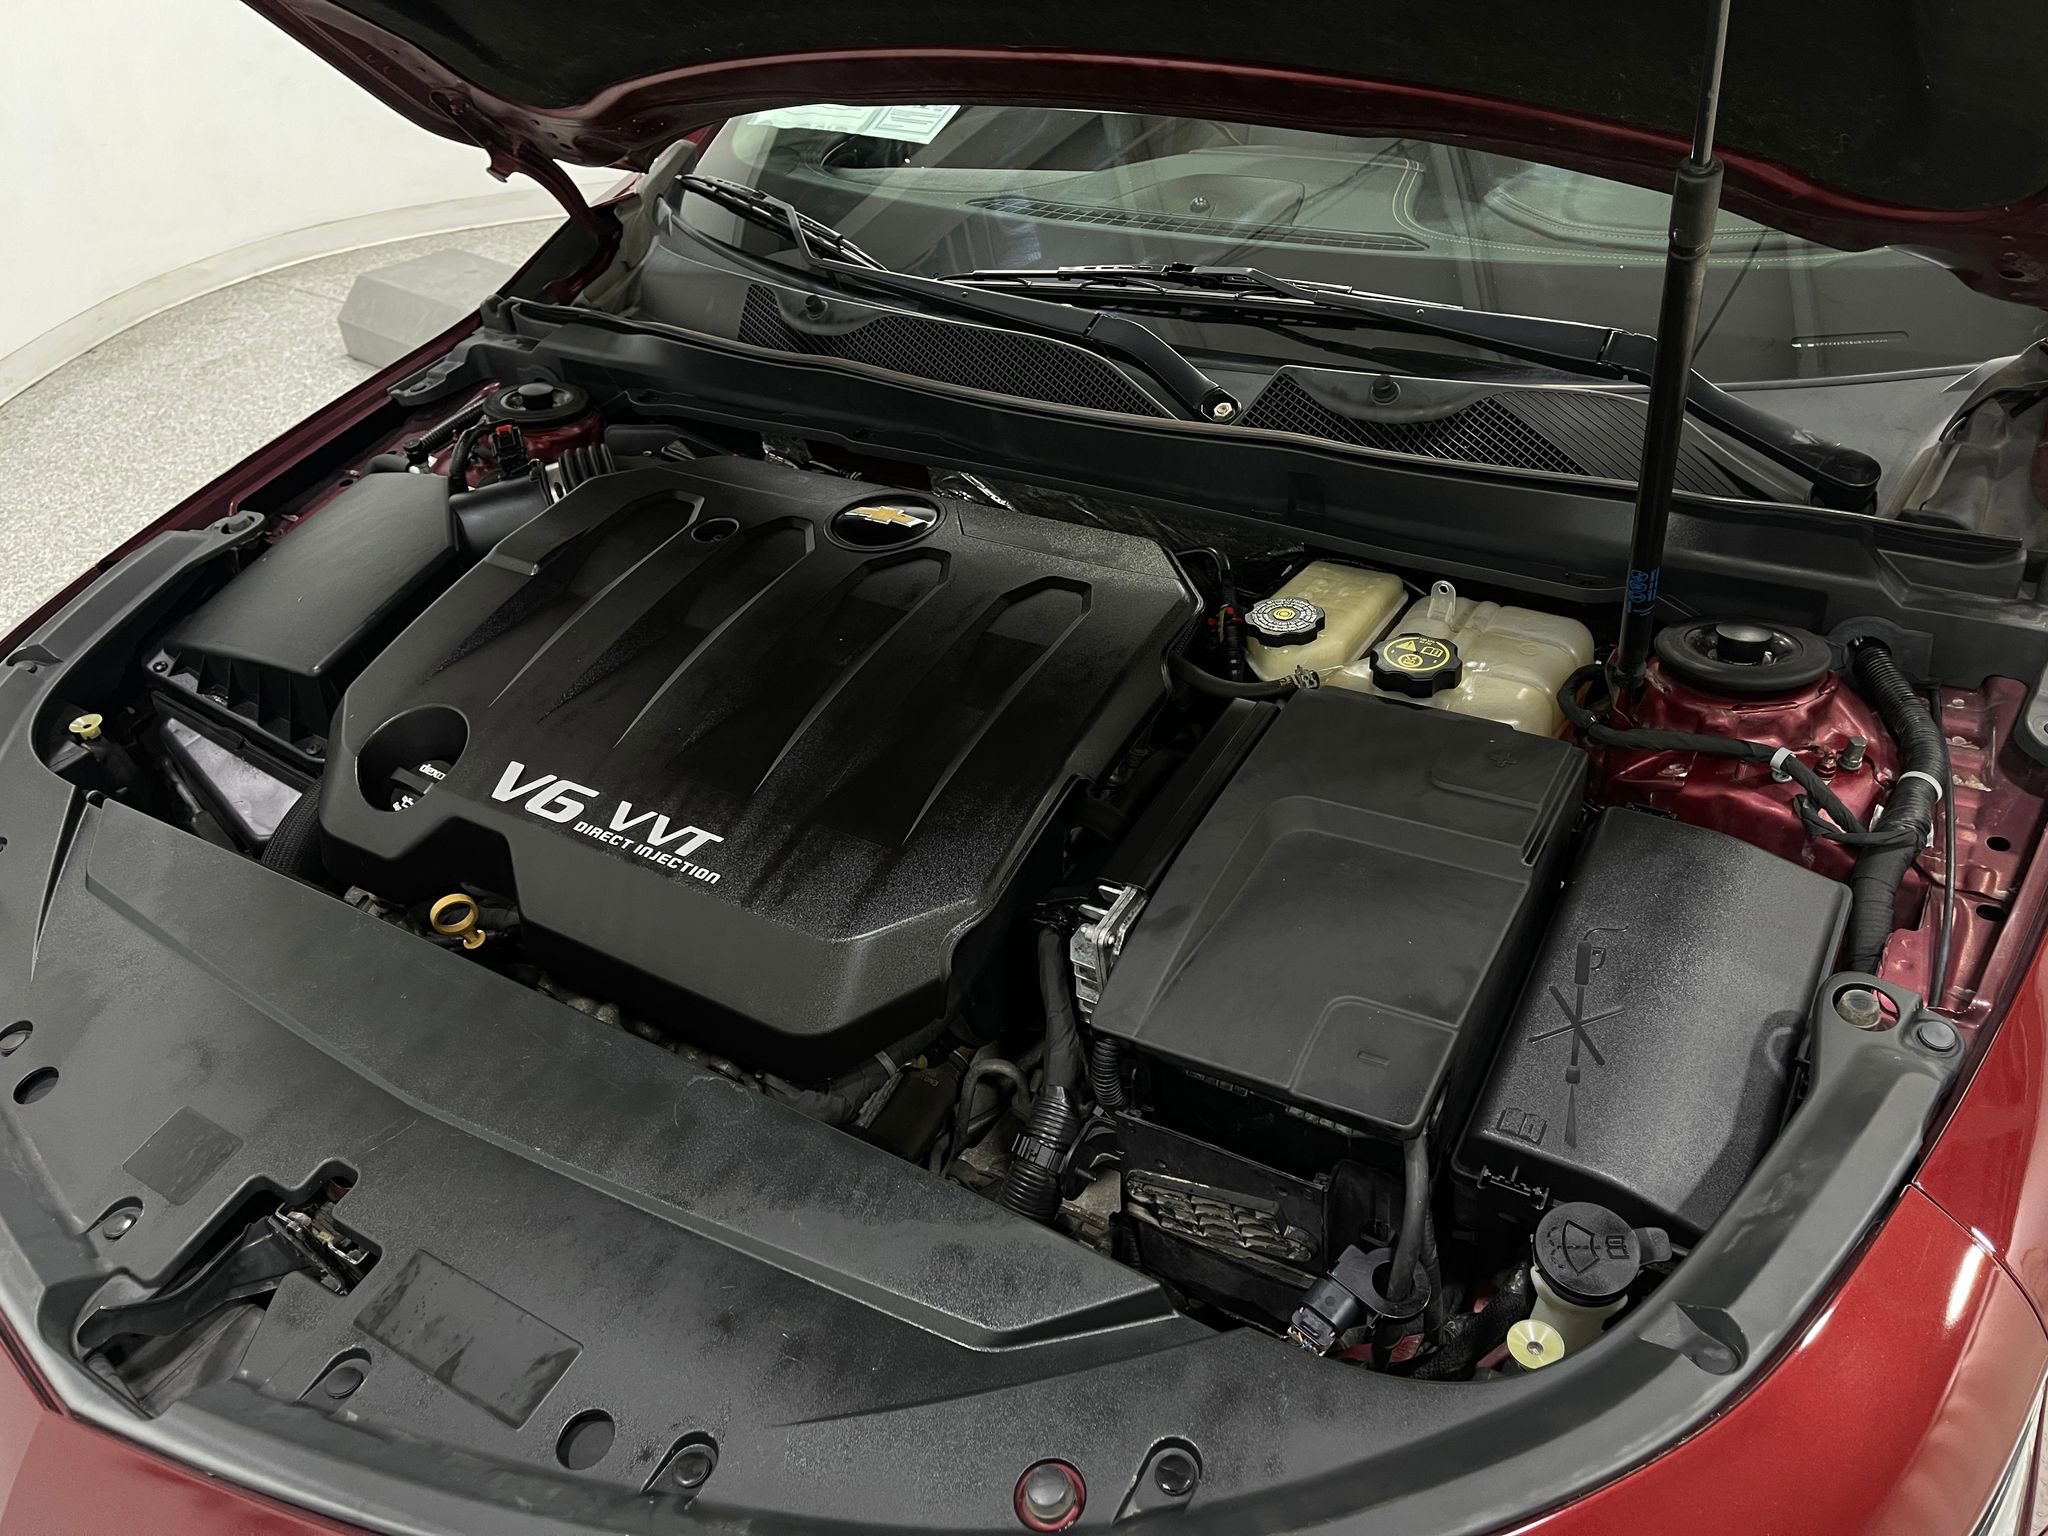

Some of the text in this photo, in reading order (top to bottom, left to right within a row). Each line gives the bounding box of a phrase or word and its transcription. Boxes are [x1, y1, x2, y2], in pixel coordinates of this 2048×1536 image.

[491, 760, 725, 857] V6 VVT
[573, 820, 721, 885] DIRECT INJECTION
